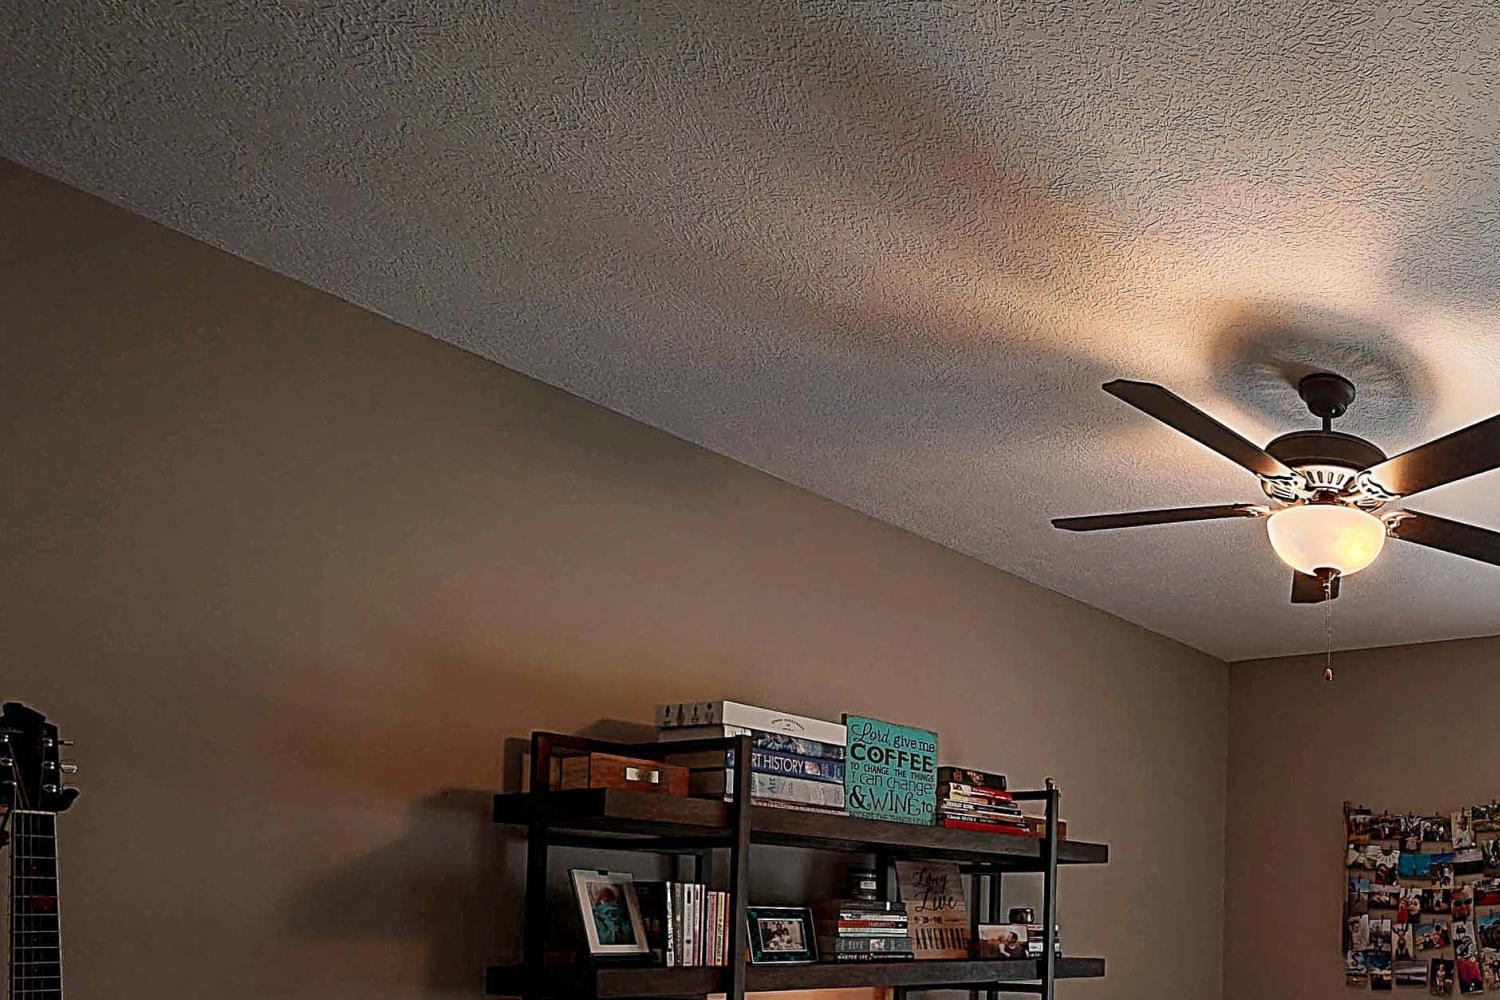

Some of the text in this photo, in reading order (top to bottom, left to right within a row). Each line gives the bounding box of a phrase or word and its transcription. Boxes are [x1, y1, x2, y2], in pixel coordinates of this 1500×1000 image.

[850, 722, 935, 753] Lord, give me
[763, 755, 804, 773] HISTORY
[850, 743, 934, 773] COFFEE
[850, 762, 935, 783] TO CHANGE THE THINGS
[852, 772, 934, 797] I can change
[849, 785, 871, 811] &
[869, 788, 921, 816] WINE
[921, 800, 934, 813] to
[914, 892, 958, 912] Live
